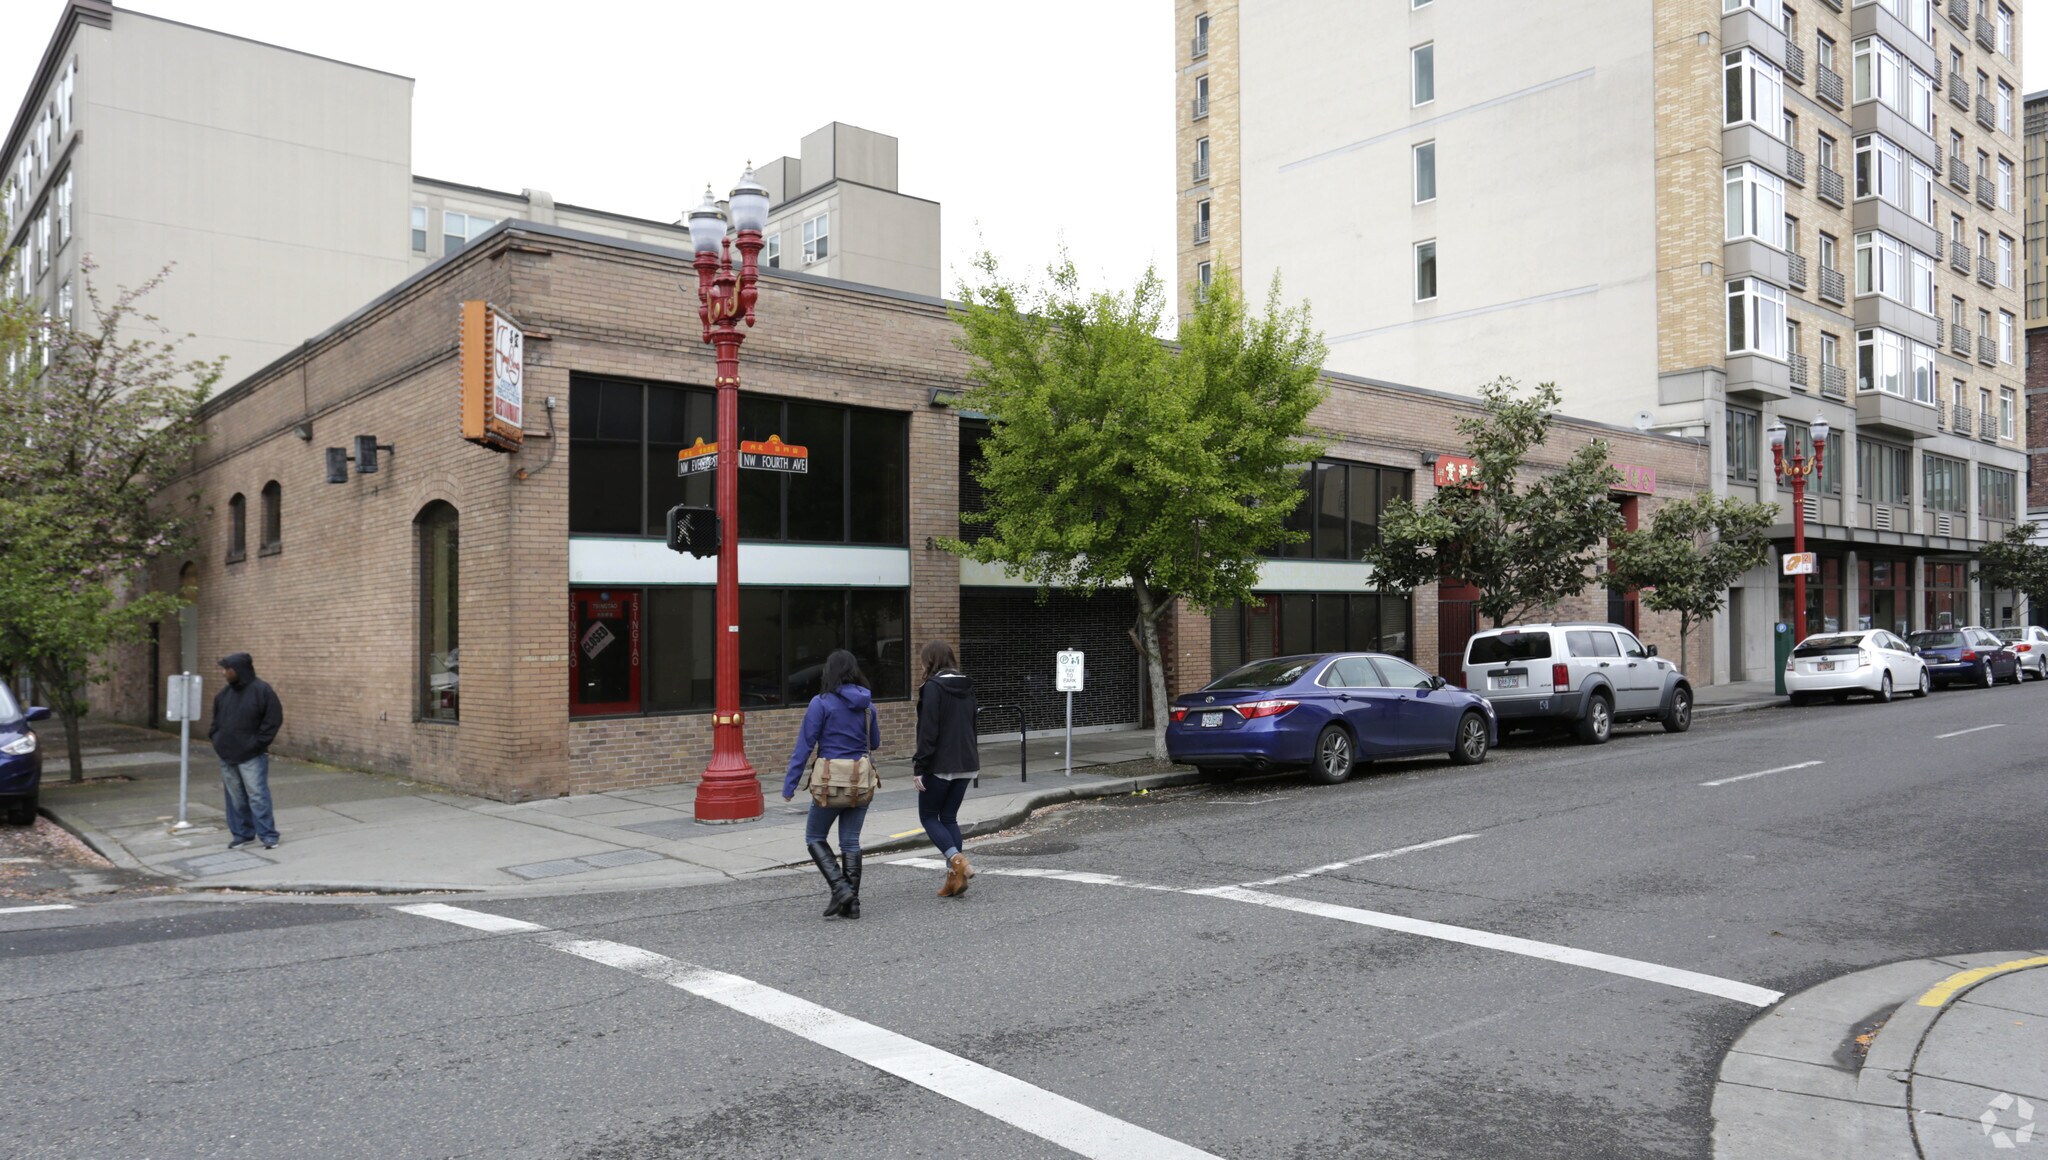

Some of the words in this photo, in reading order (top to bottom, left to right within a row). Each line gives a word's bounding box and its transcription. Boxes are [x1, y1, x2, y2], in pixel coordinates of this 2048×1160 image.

[680, 460, 689, 474] NW
[743, 454, 757, 468] NW
[761, 455, 789, 470] FOURTH
[792, 458, 806, 471] AVE
[592, 602, 618, 610] TSINGTAO
[569, 592, 578, 668] TSINGTAO
[583, 625, 609, 653] CLOSED
[632, 592, 640, 666] TSINGTAO
